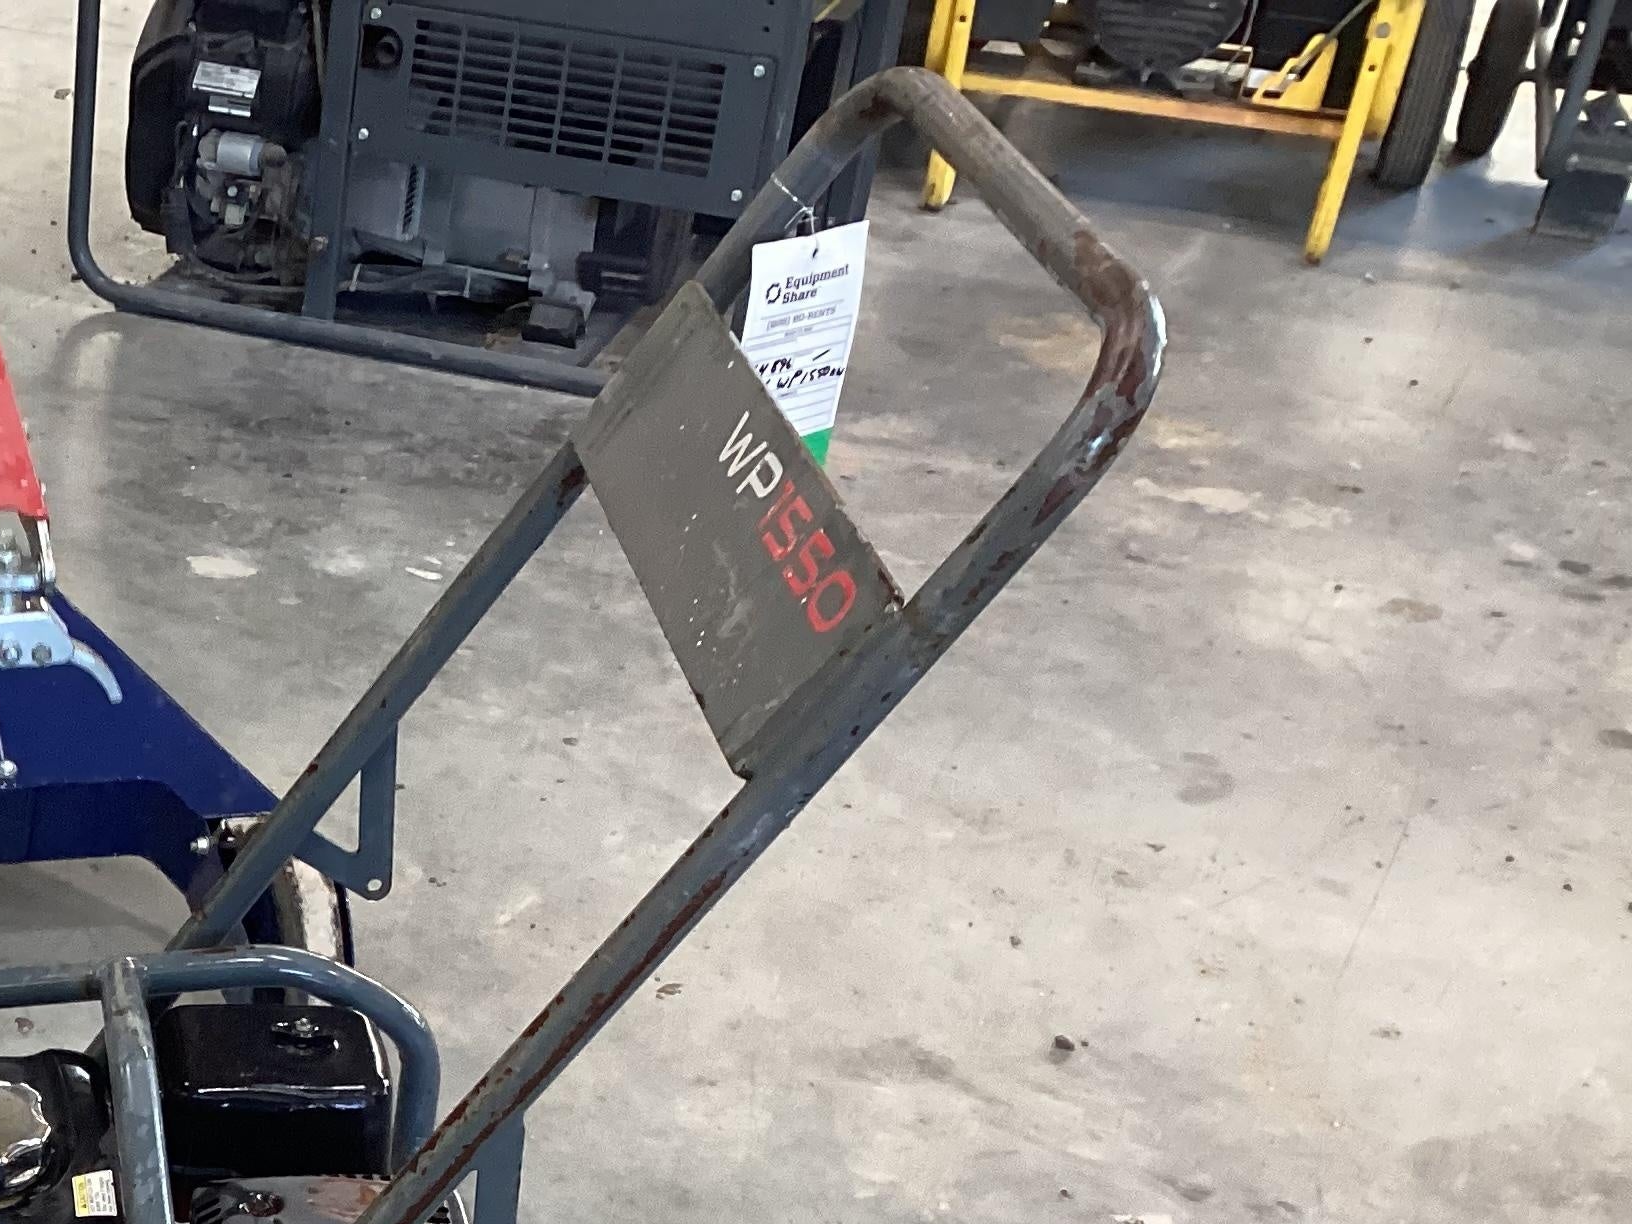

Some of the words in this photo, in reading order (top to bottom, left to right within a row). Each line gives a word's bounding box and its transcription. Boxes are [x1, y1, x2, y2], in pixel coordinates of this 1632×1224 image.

[785, 264, 849, 290] Equipment
[782, 288, 818, 304] Share
[719, 410, 857, 633] WP1550
